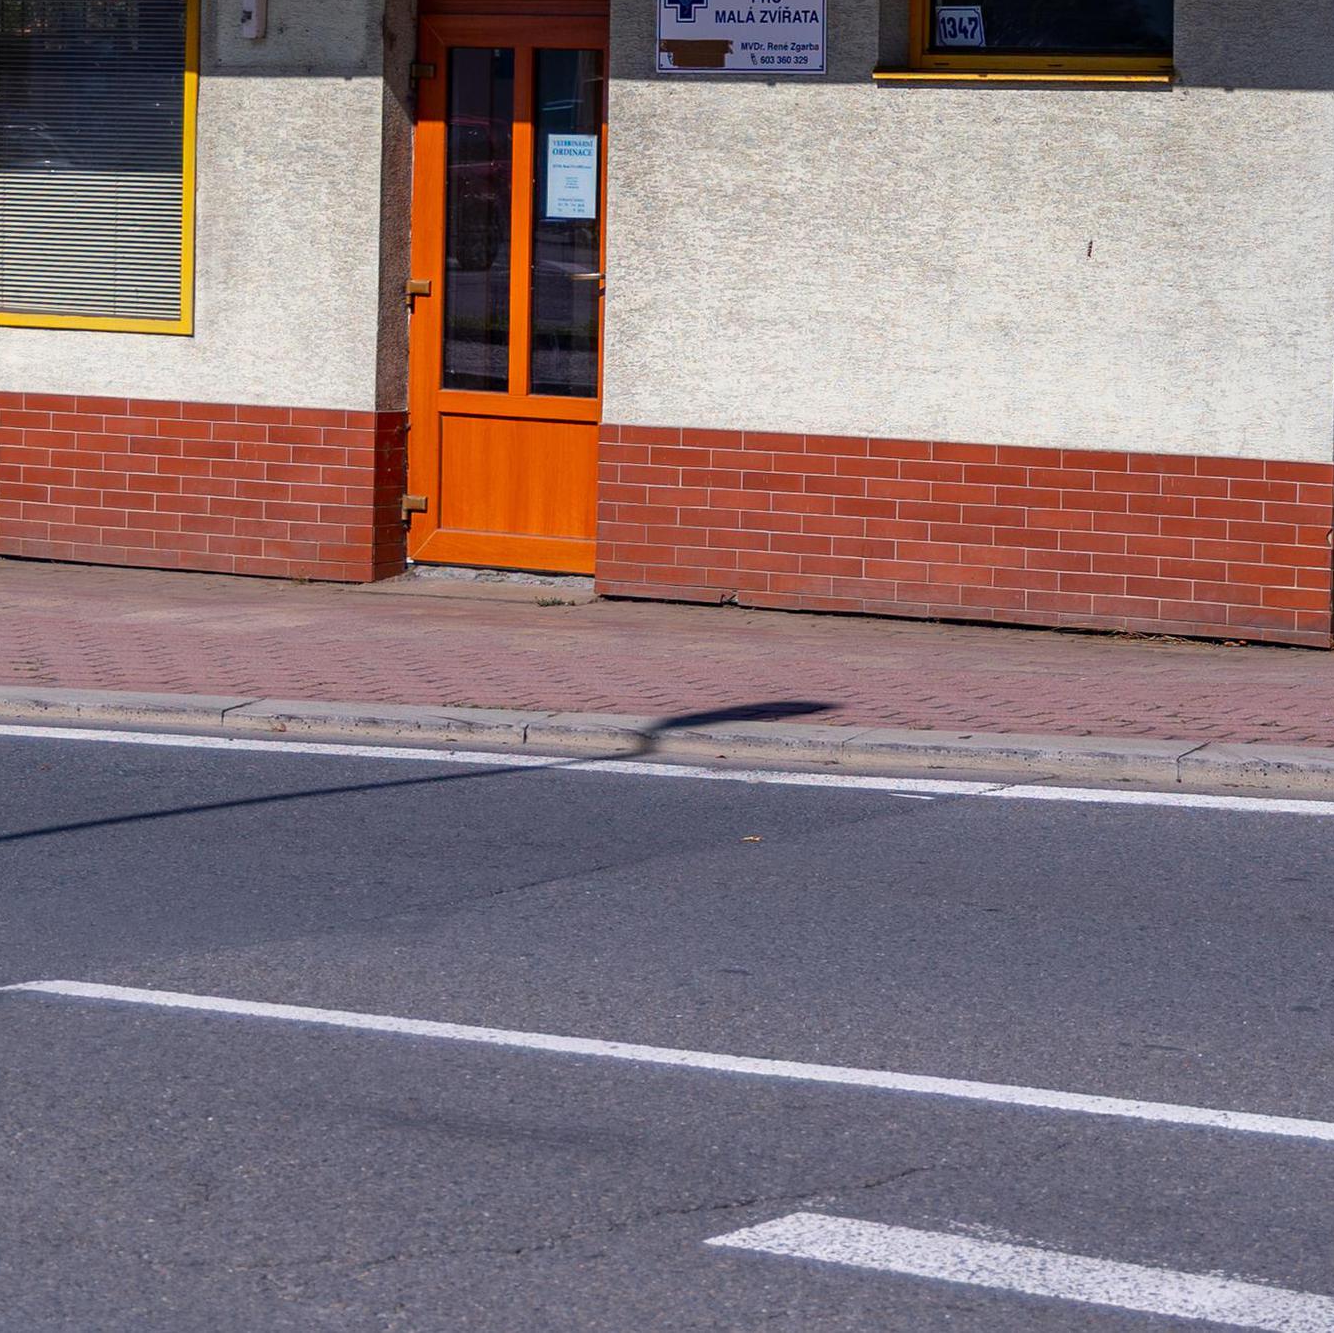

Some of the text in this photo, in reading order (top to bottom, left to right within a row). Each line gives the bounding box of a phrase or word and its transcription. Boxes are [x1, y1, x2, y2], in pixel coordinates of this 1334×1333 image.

[715, 6, 820, 23] MALÁ ZVÍŘATA
[941, 17, 978, 39] 1347
[741, 42, 765, 51] MVDr.
[767, 41, 789, 51] René
[552, 148, 593, 156] ORDINACE
